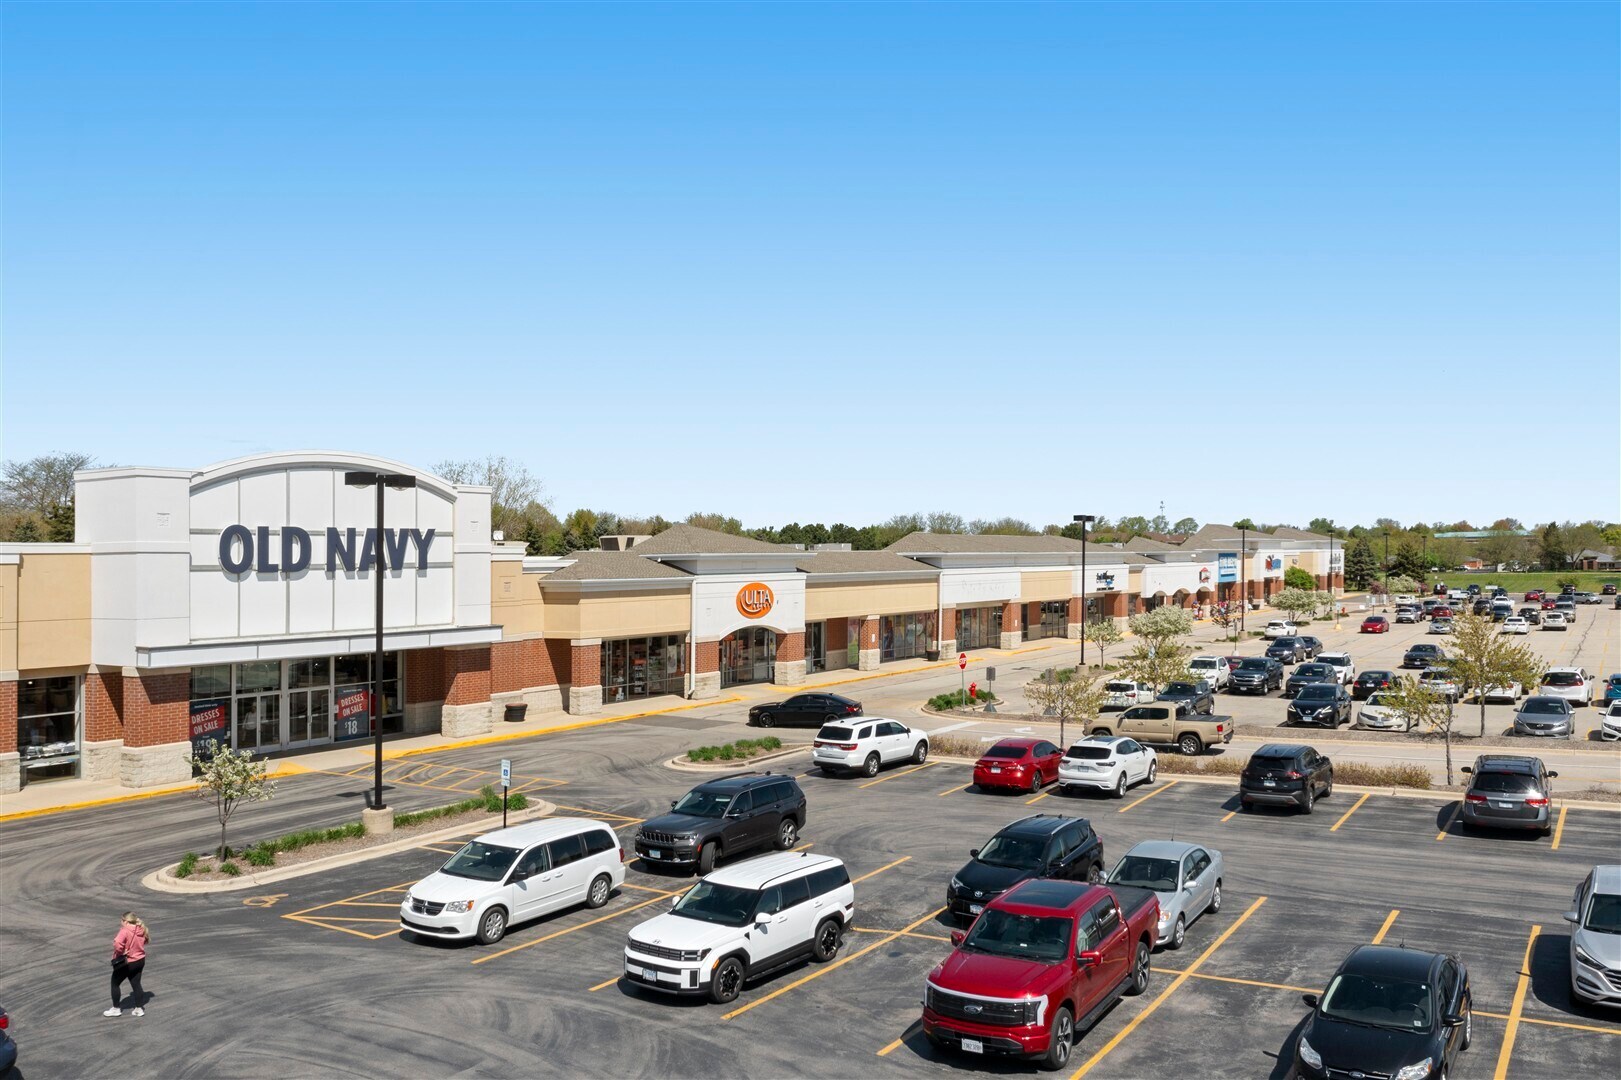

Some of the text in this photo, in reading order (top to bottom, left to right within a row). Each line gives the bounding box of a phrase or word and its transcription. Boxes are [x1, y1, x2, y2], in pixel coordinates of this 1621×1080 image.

[218, 524, 436, 575] OLD NAVY
[745, 589, 771, 605] ULTA
[341, 693, 364, 707] DRESSES
[191, 708, 220, 725] DRESSES
[342, 703, 363, 717] ON SALE
[193, 720, 219, 735] ON SALE
[344, 720, 358, 735] $18
